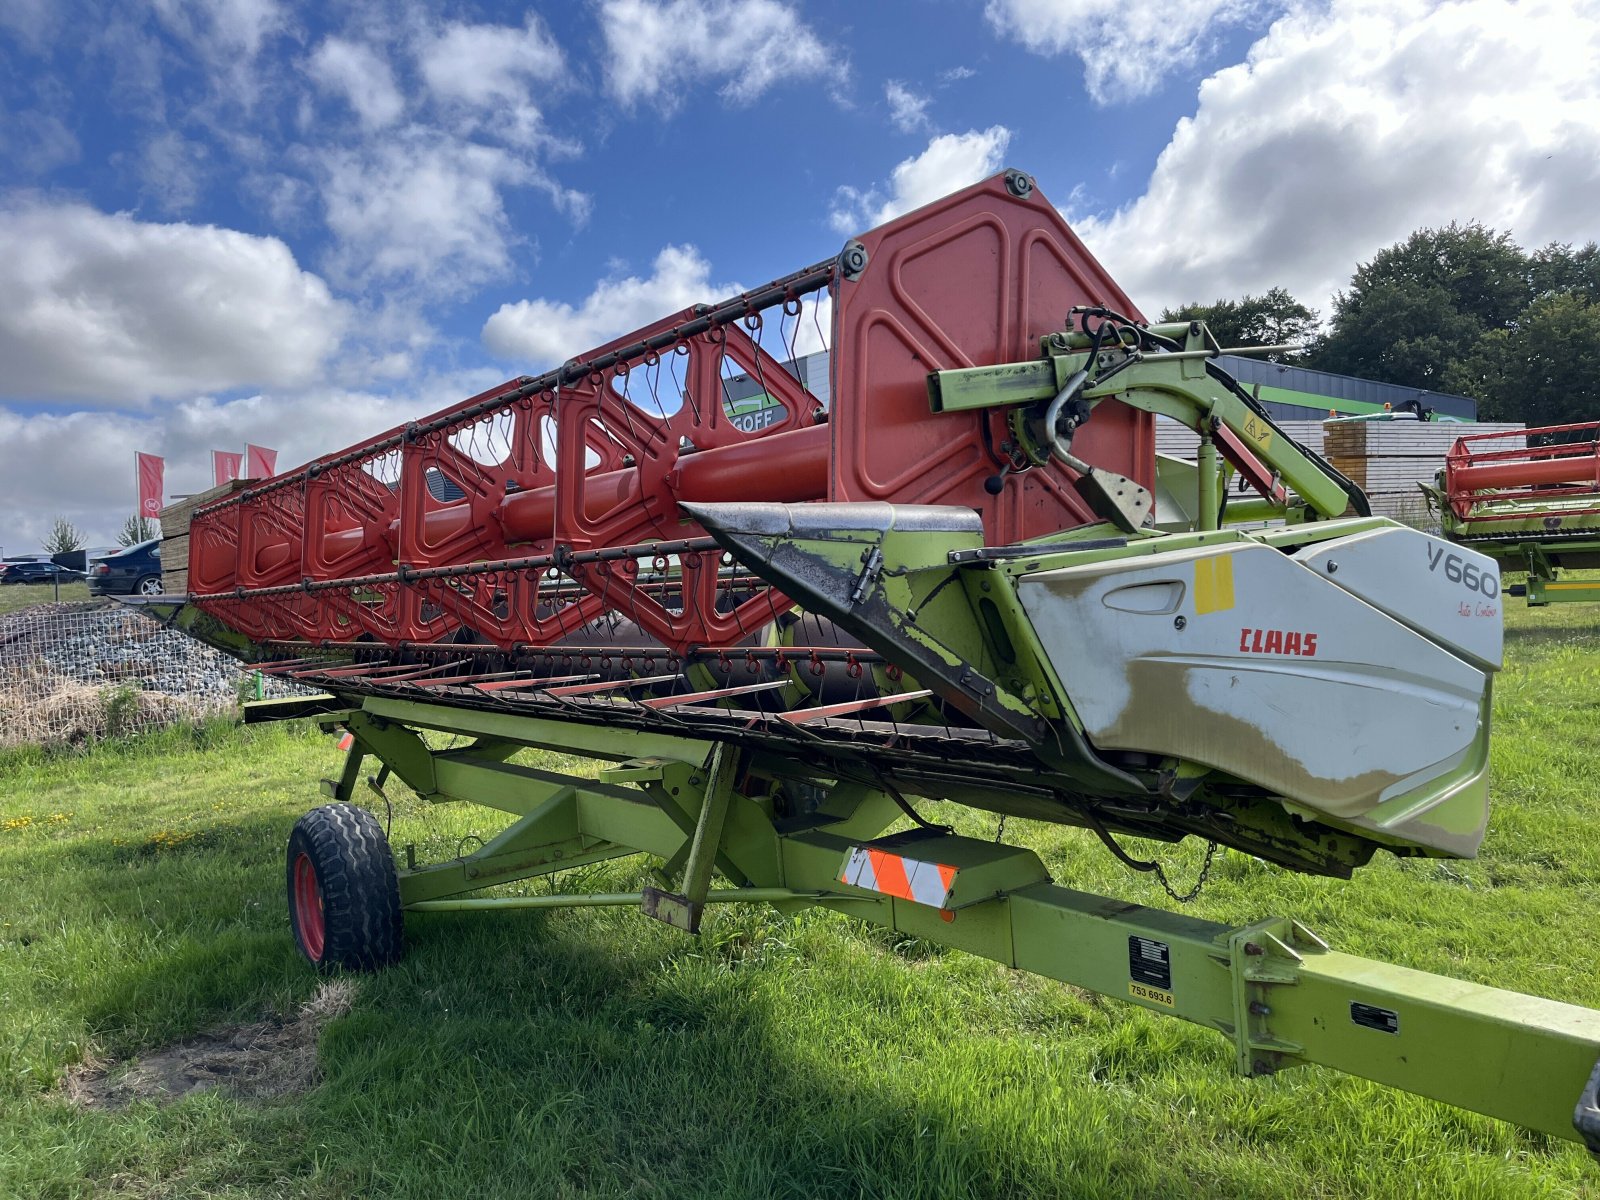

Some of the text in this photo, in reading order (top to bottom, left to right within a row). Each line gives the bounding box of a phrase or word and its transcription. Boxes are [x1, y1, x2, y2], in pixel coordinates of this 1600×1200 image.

[1240, 628, 1317, 656] CLAAS
[1131, 984, 1172, 1004] 753 693.6
